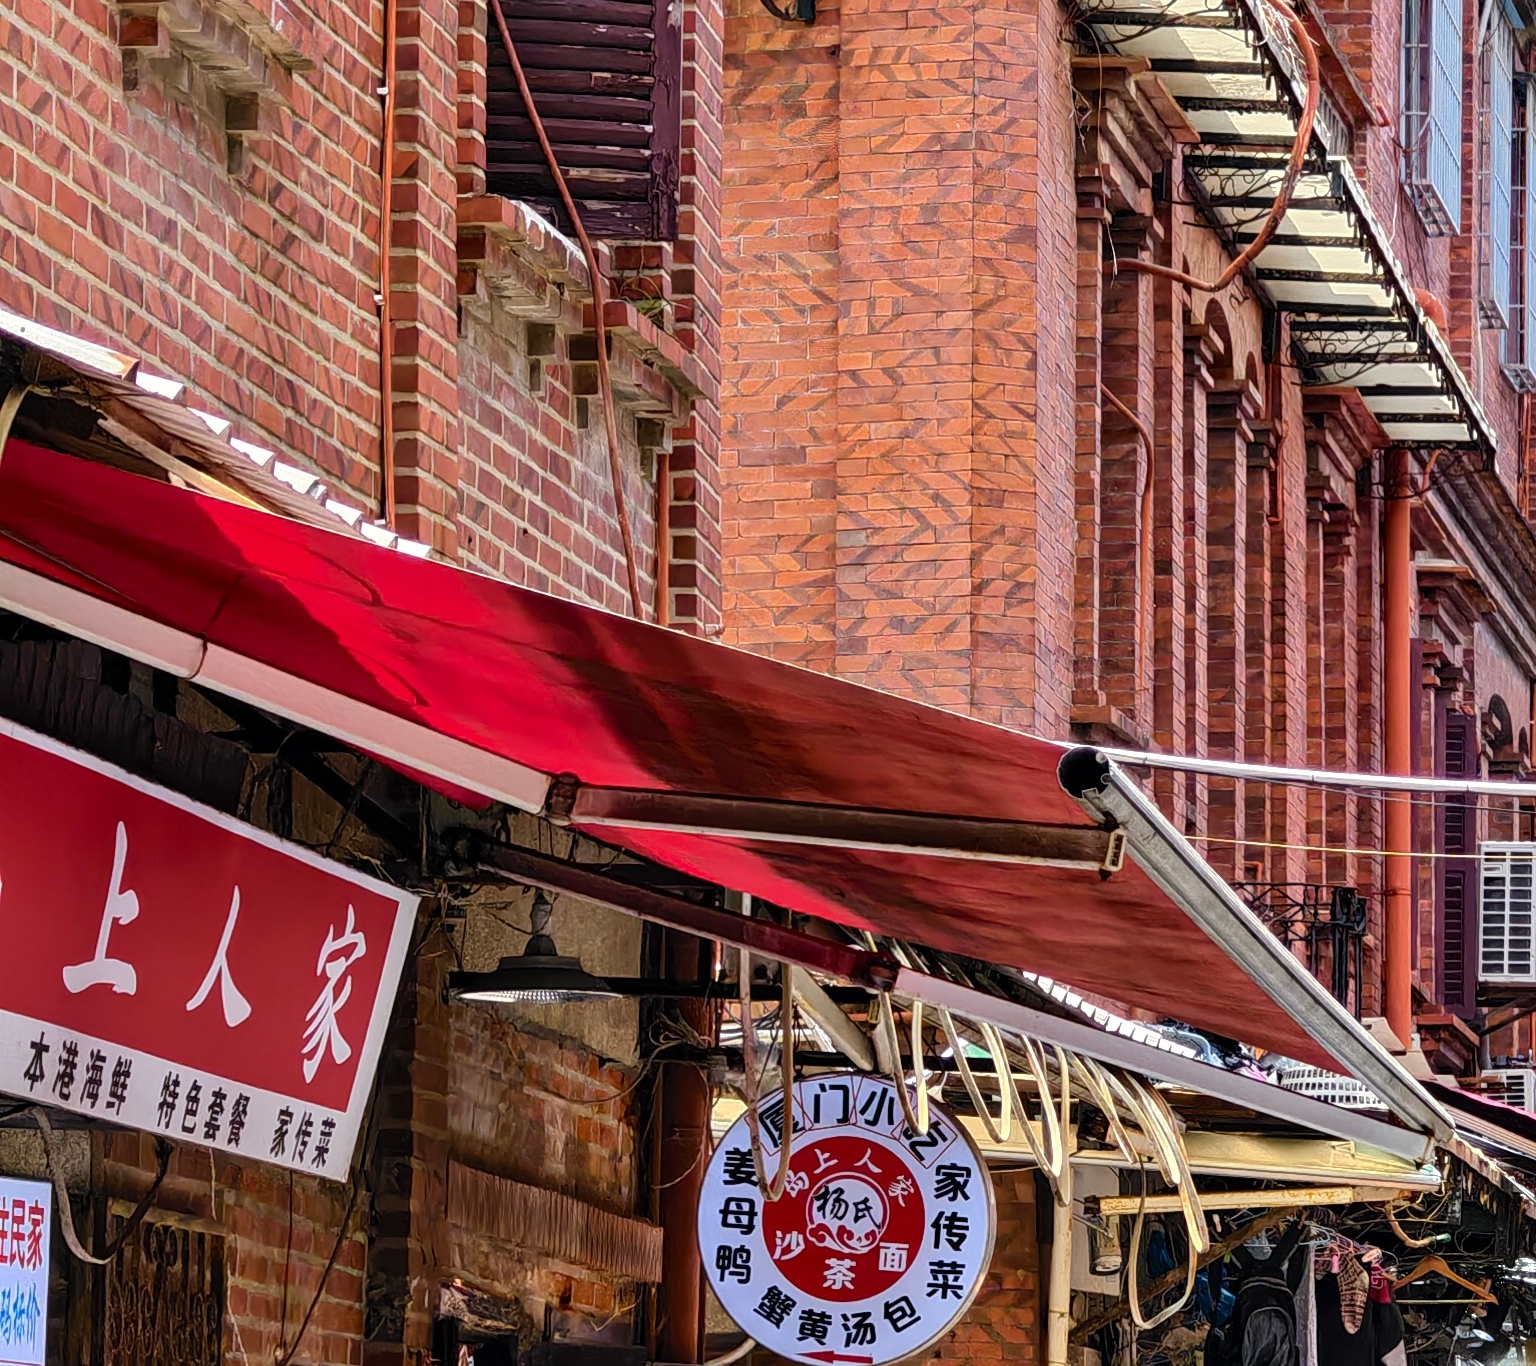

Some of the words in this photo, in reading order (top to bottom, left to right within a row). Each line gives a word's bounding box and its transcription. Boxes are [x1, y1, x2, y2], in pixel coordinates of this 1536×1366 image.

[0, 820, 367, 1084] 上人家
[23, 1031, 133, 1116] 本港海鲜
[157, 1071, 251, 1148] 特色套餐
[270, 1106, 337, 1168] 家传菜
[761, 1083, 949, 1162] 厦门小吃
[716, 1147, 758, 1285] 姜母鸭
[784, 1147, 915, 1207] 岛上人家
[813, 1184, 882, 1230] 杨氏
[773, 1230, 910, 1290] 沙茶面
[926, 1162, 972, 1301] 家传菜
[753, 1285, 922, 1348] 蟹黄汤包
